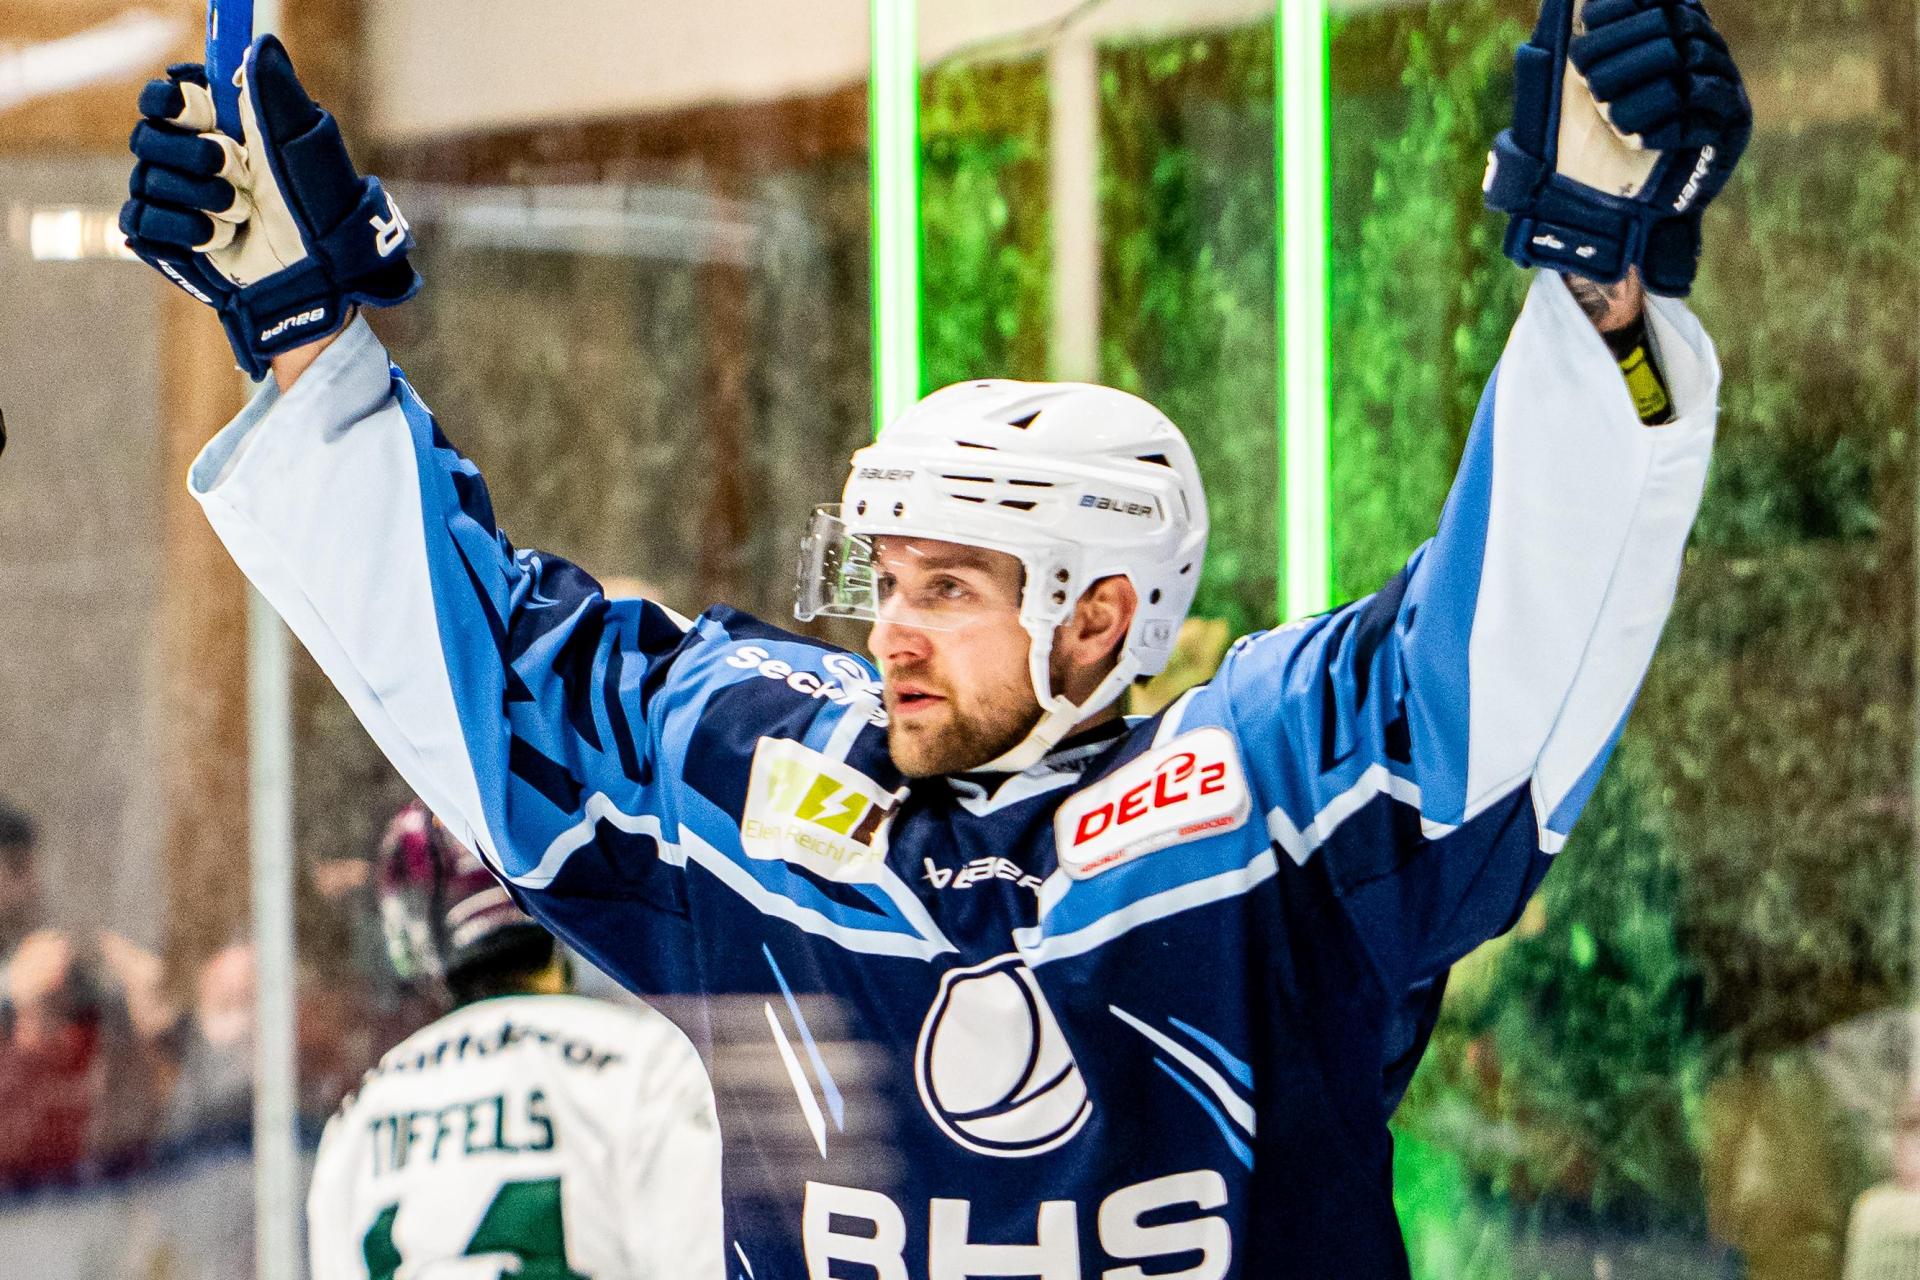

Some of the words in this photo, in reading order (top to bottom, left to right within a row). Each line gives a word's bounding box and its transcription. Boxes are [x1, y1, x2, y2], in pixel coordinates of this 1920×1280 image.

[1079, 494, 1154, 519] BAUER
[366, 1088, 555, 1178] TIFFELS
[803, 1169, 1232, 1280] BHS
